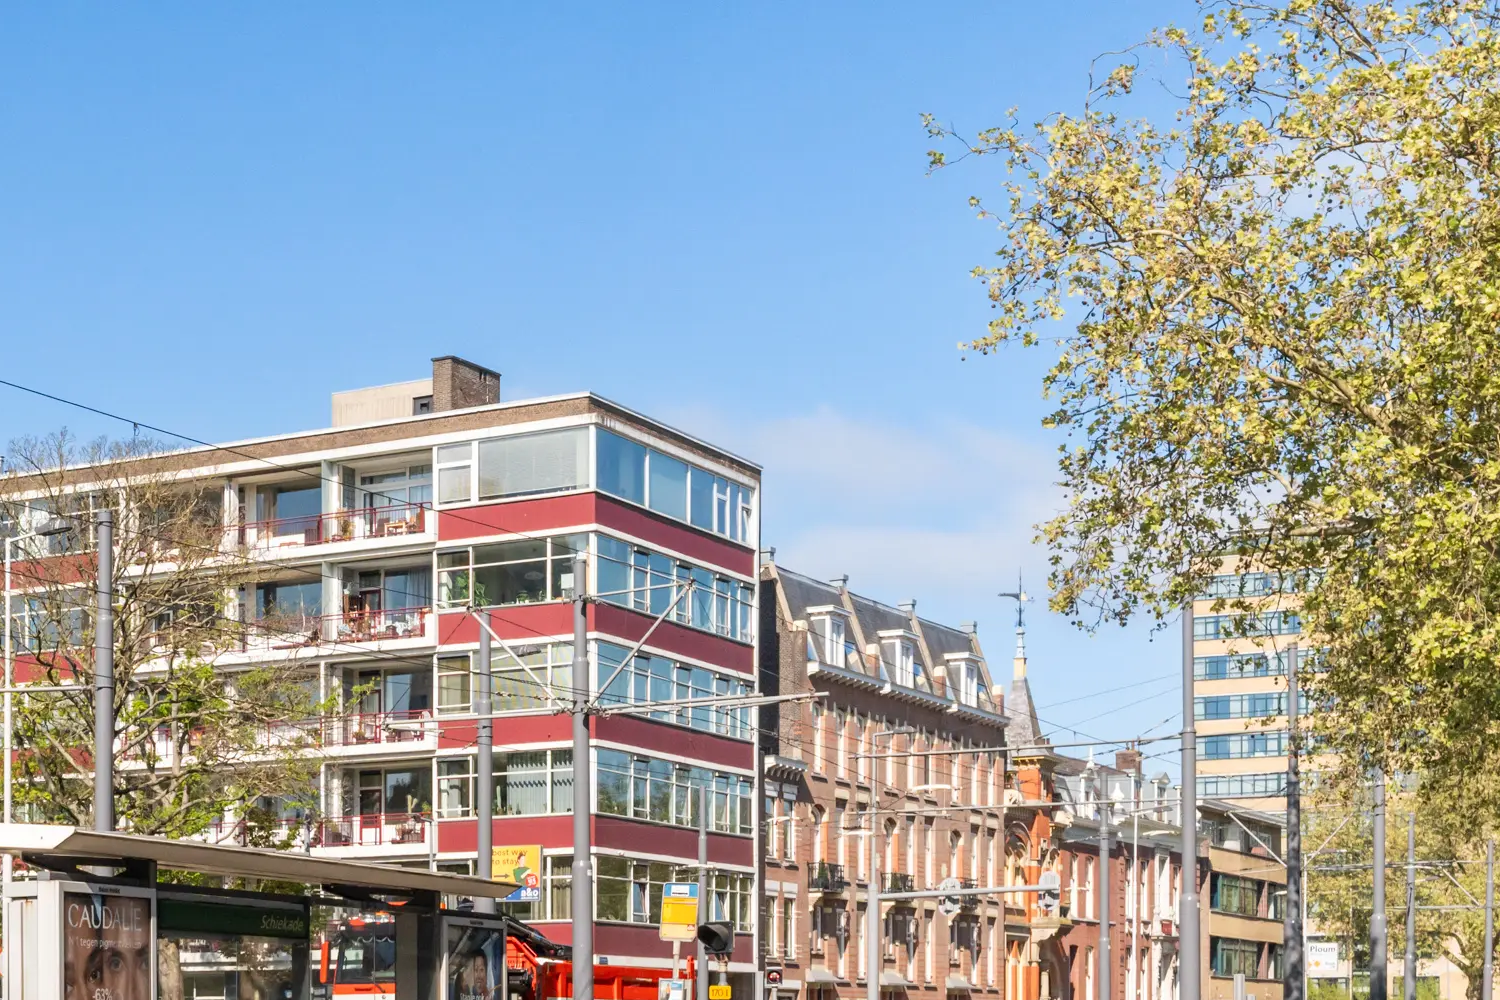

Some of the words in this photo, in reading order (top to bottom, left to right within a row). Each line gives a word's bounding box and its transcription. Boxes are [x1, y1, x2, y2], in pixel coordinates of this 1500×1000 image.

[260, 914, 304, 931] Schiekade
[80, 937, 99, 948] tegen
[1310, 945, 1336, 953] Ploum
